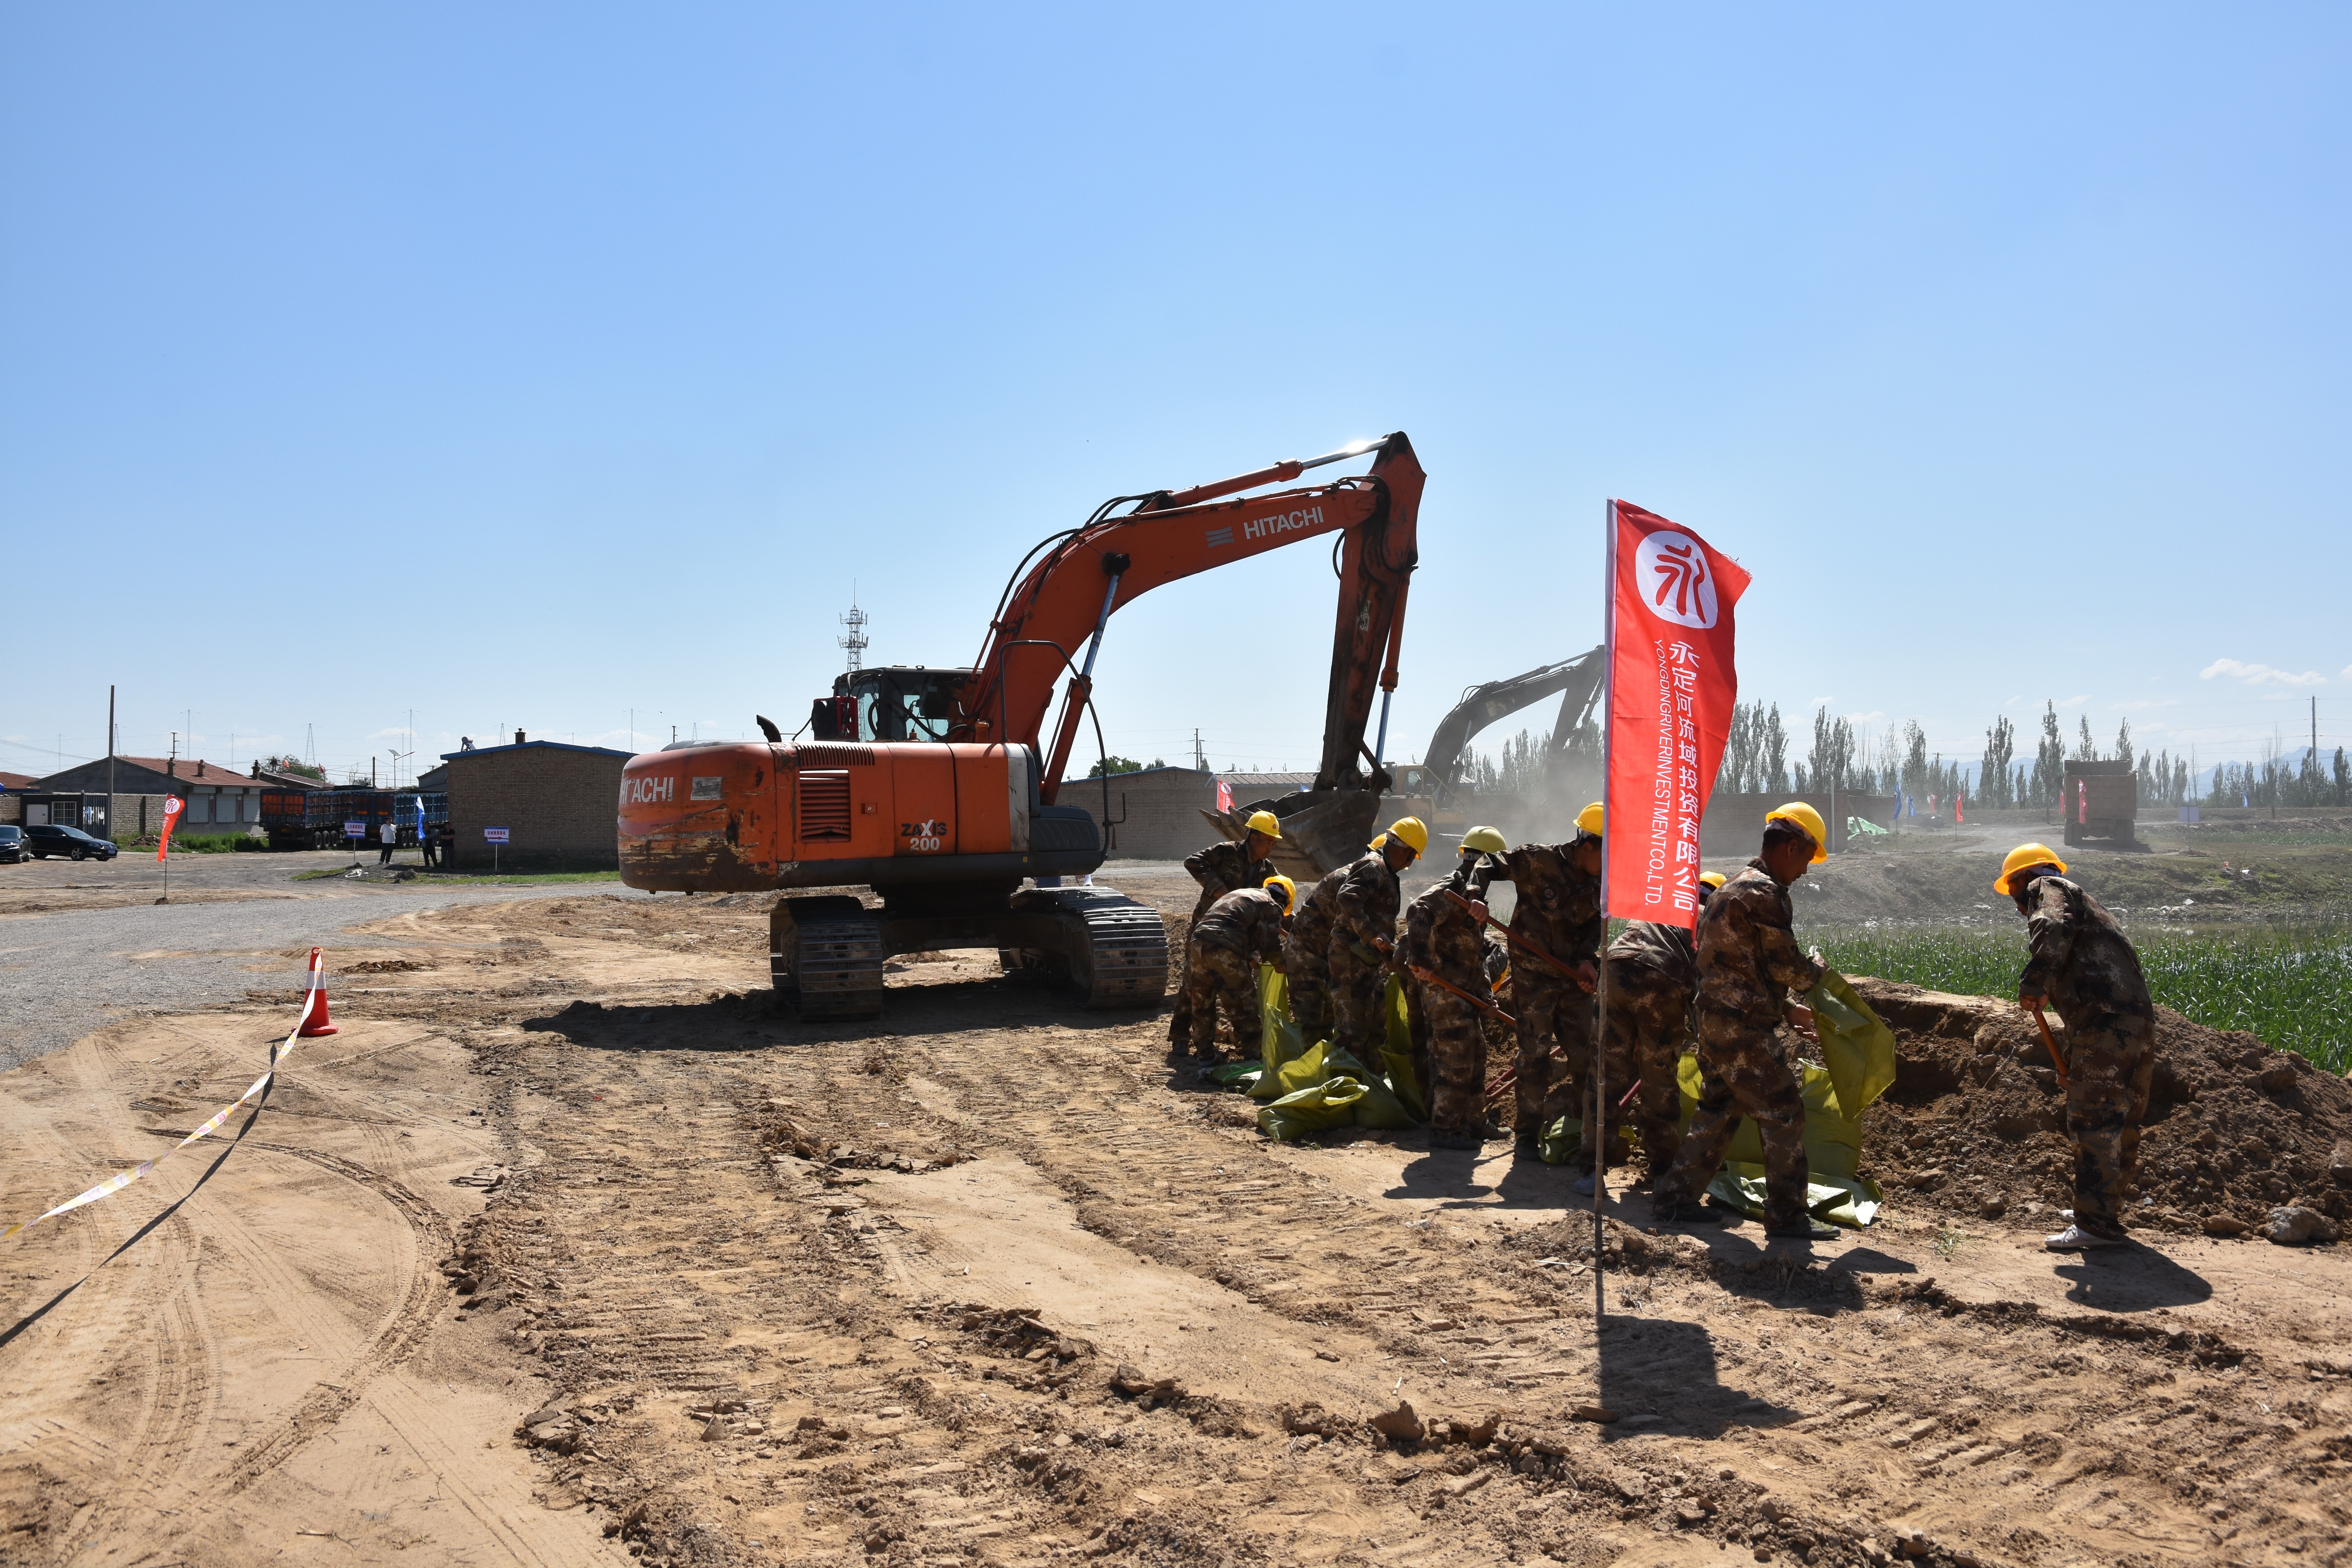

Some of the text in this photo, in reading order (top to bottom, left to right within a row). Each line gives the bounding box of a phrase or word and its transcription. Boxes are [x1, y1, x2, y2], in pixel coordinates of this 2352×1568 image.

[1243, 506, 1324, 539] HITACHI
[1669, 641, 1700, 916] 永定河流域投资有限公司
[901, 819, 947, 836] ZAXIS
[909, 837, 940, 851] 200
